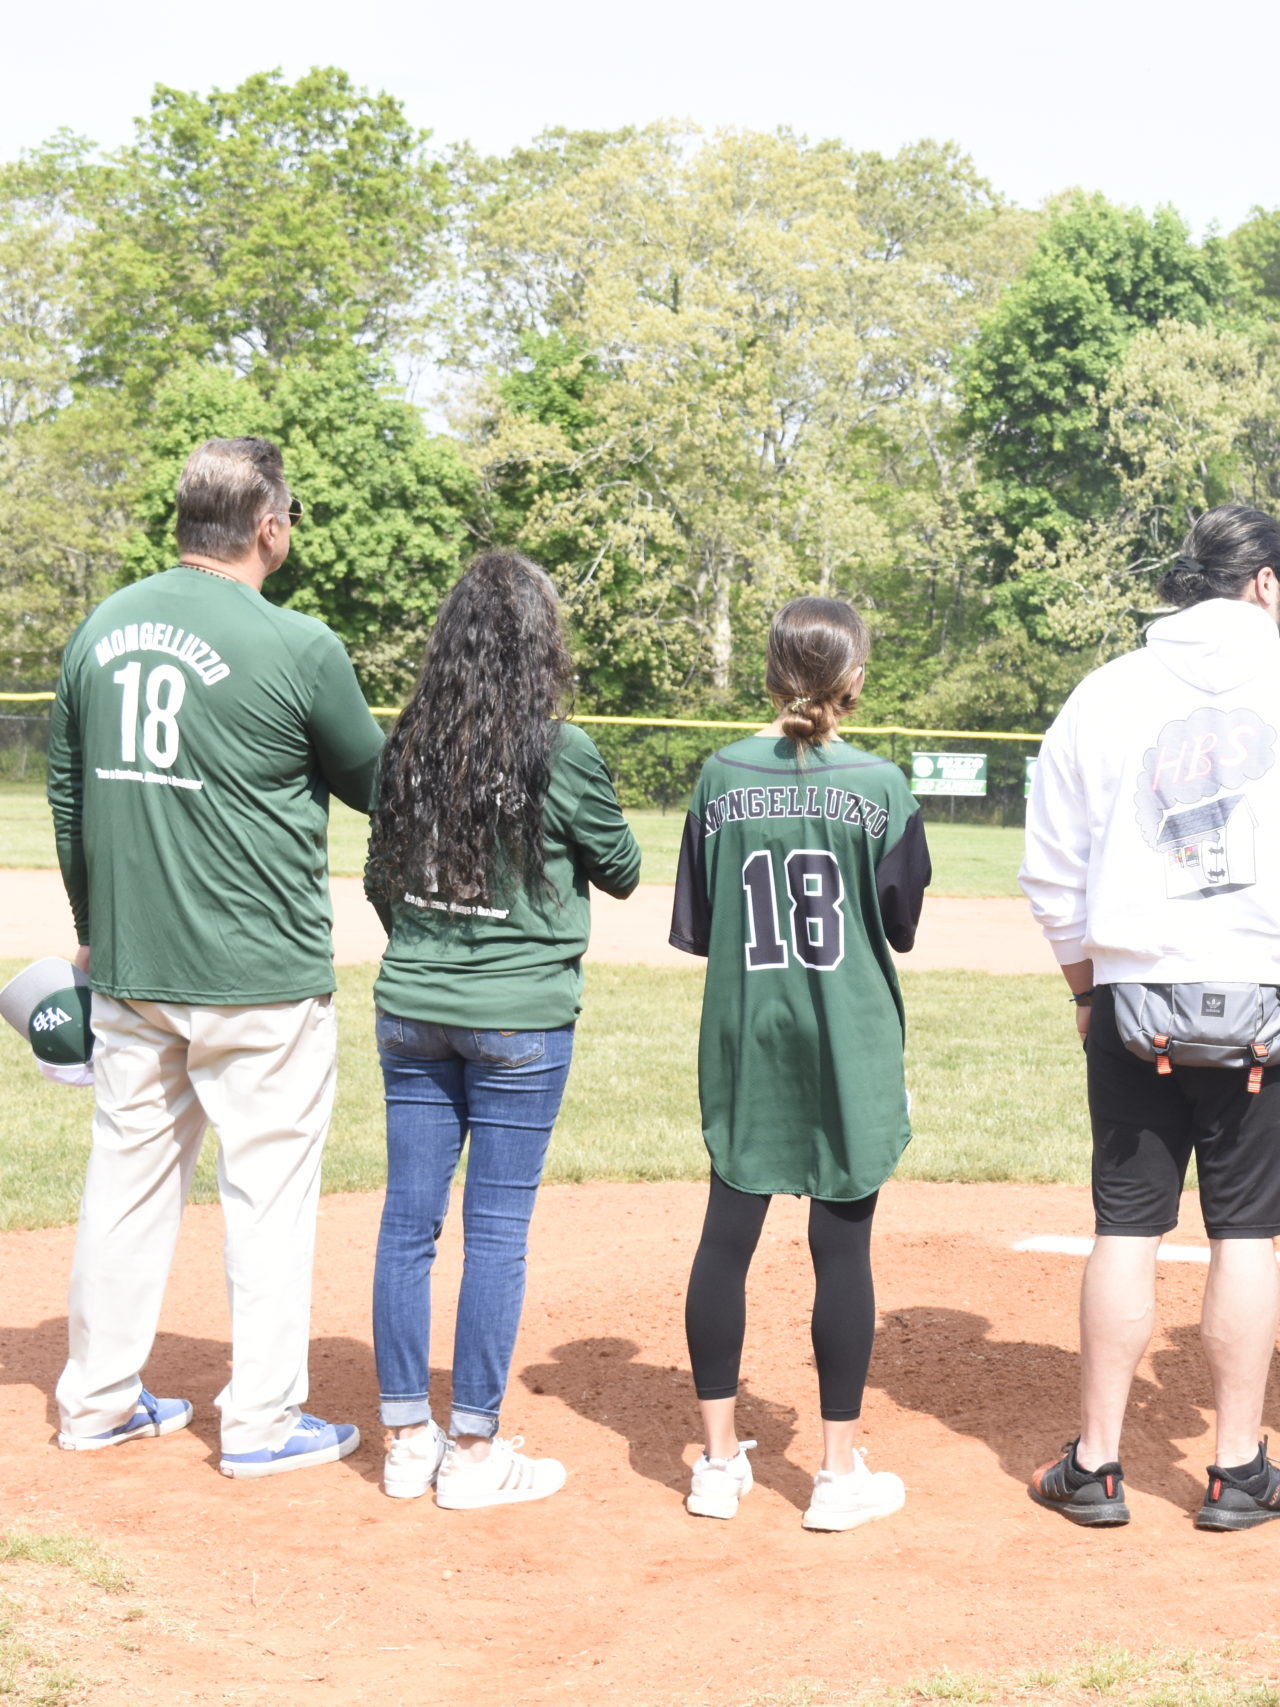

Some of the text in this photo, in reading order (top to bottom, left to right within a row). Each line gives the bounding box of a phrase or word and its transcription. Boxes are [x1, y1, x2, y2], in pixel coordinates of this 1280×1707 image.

[95, 622, 231, 686] MONGELLUZZO
[113, 661, 186, 769] 18
[1151, 723, 1258, 793] HBS
[704, 785, 889, 839] MONGELLUZZO
[742, 849, 844, 971] 18
